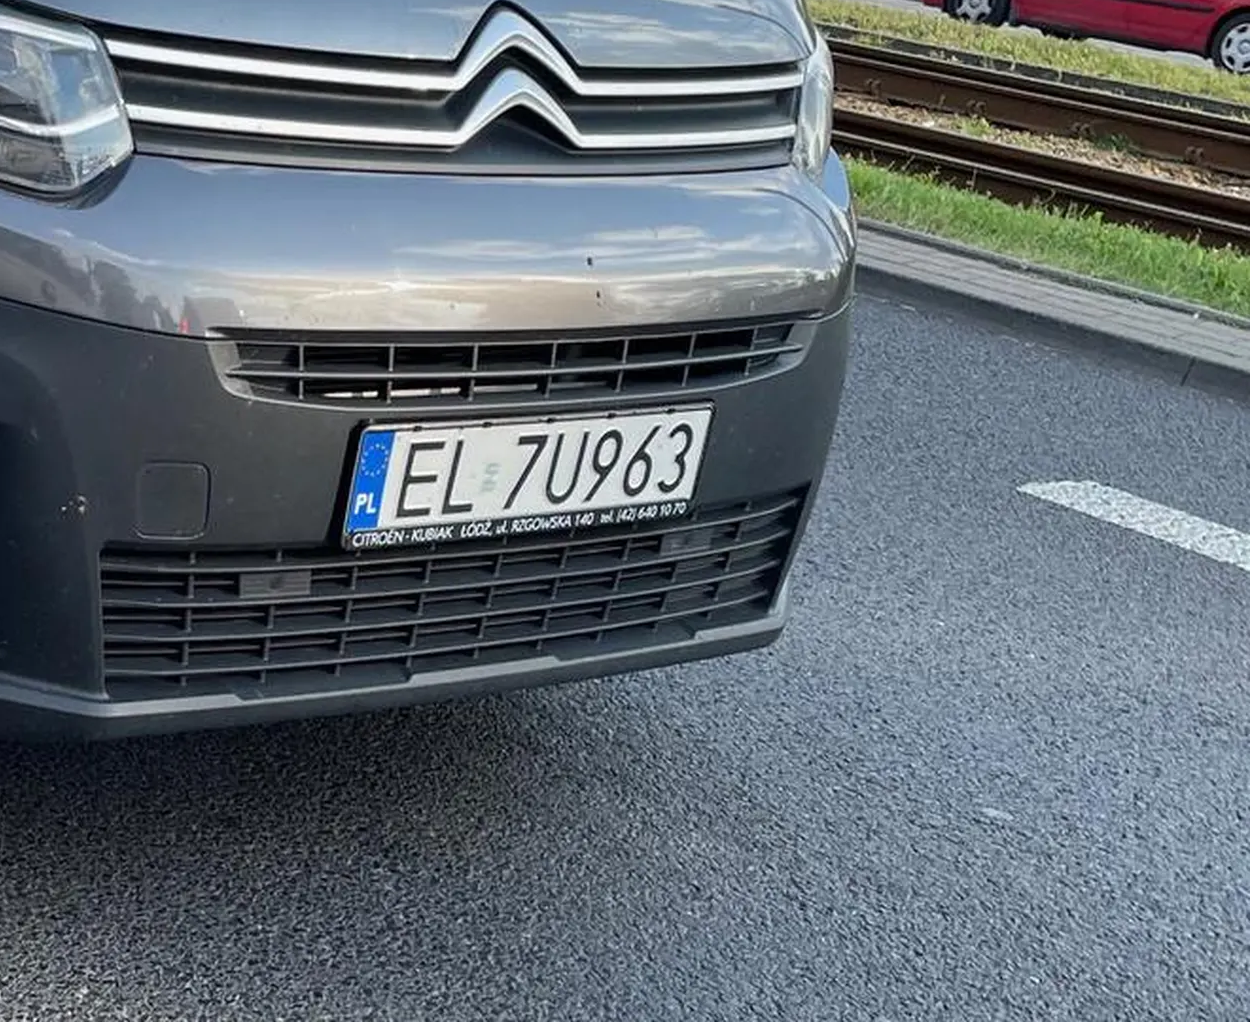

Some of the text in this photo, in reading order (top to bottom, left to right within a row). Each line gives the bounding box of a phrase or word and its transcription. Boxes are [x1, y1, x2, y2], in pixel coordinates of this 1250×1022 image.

[395, 422, 694, 519] EL 7U963
[353, 492, 377, 515] PL
[411, 526, 453, 542] KUBIAK
[510, 516, 572, 533] RZGOWSKA
[575, 512, 595, 527] 140
